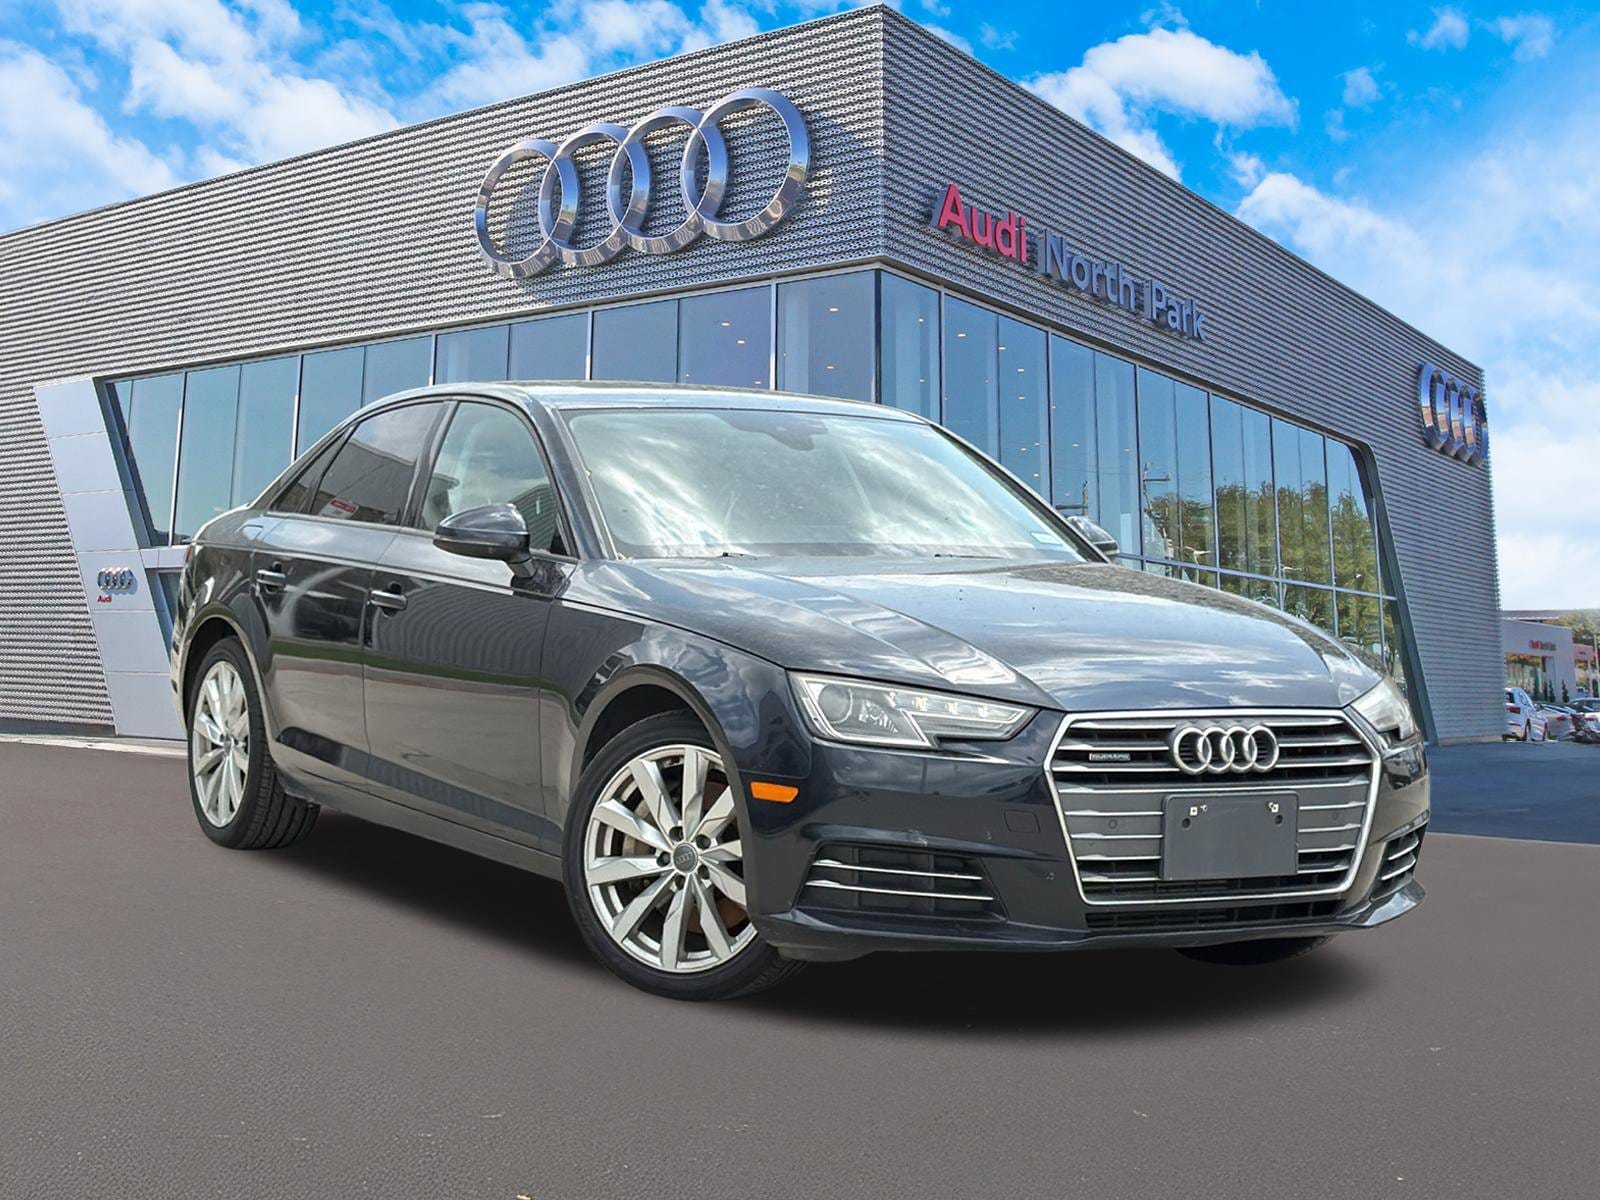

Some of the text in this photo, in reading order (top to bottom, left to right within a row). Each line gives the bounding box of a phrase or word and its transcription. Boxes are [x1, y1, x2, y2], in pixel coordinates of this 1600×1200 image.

[932, 183, 1208, 341] Audi North Park
[97, 595, 112, 603] Audi
